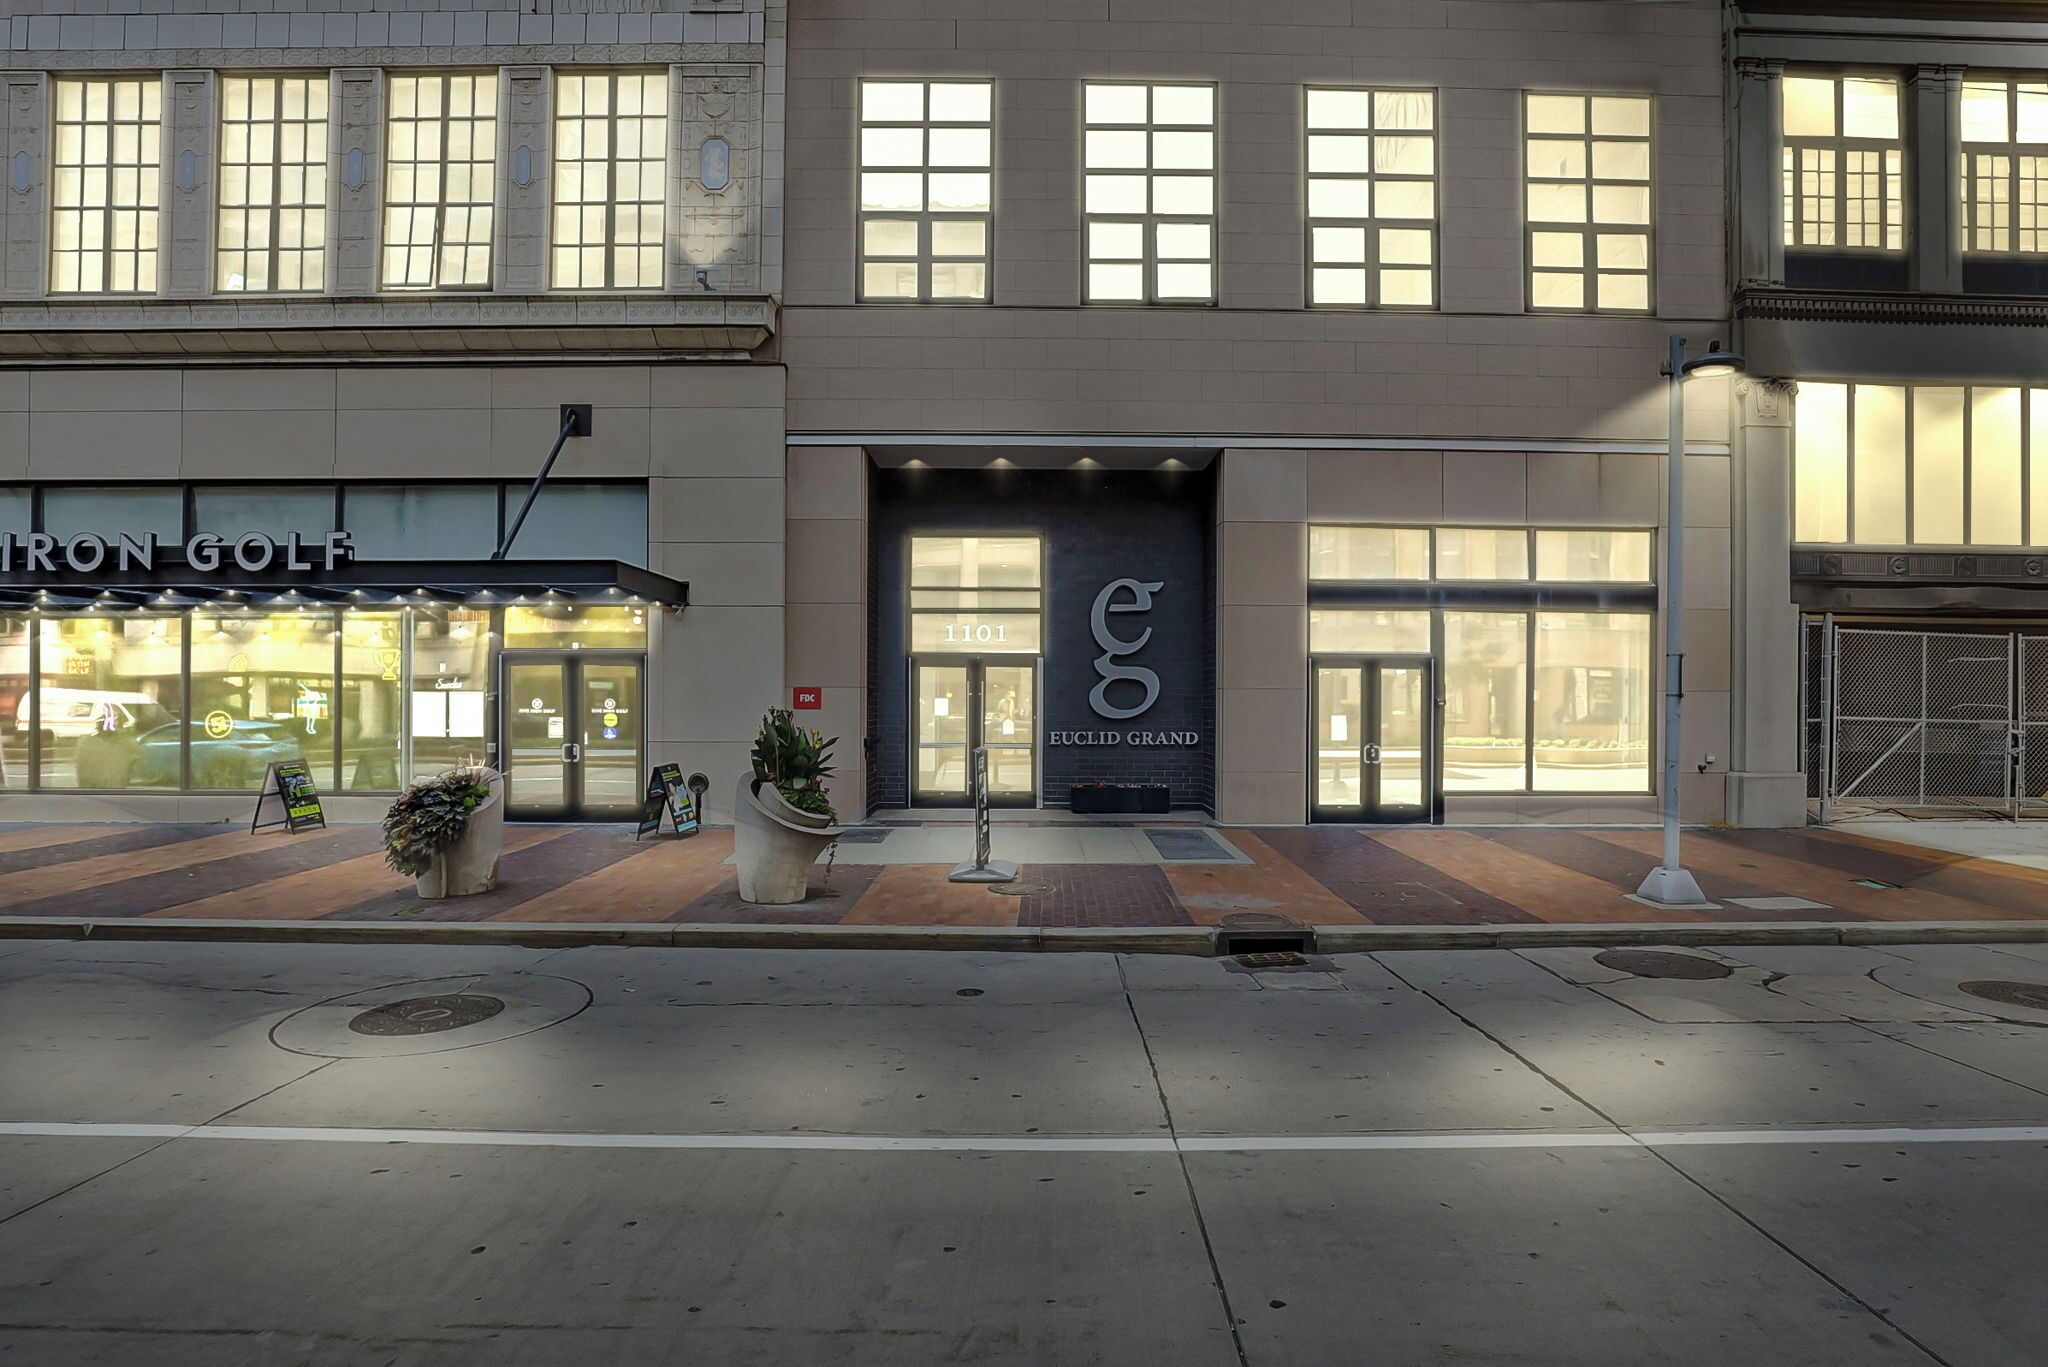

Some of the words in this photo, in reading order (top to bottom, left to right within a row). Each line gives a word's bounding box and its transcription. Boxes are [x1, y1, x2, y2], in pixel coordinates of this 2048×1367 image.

[1, 531, 157, 572] IRON
[186, 531, 354, 572] GOLF
[944, 624, 1007, 642] 1101
[799, 693, 815, 703] FDC
[1049, 731, 1121, 745] EUCLID
[1126, 731, 1199, 745] GRAND
